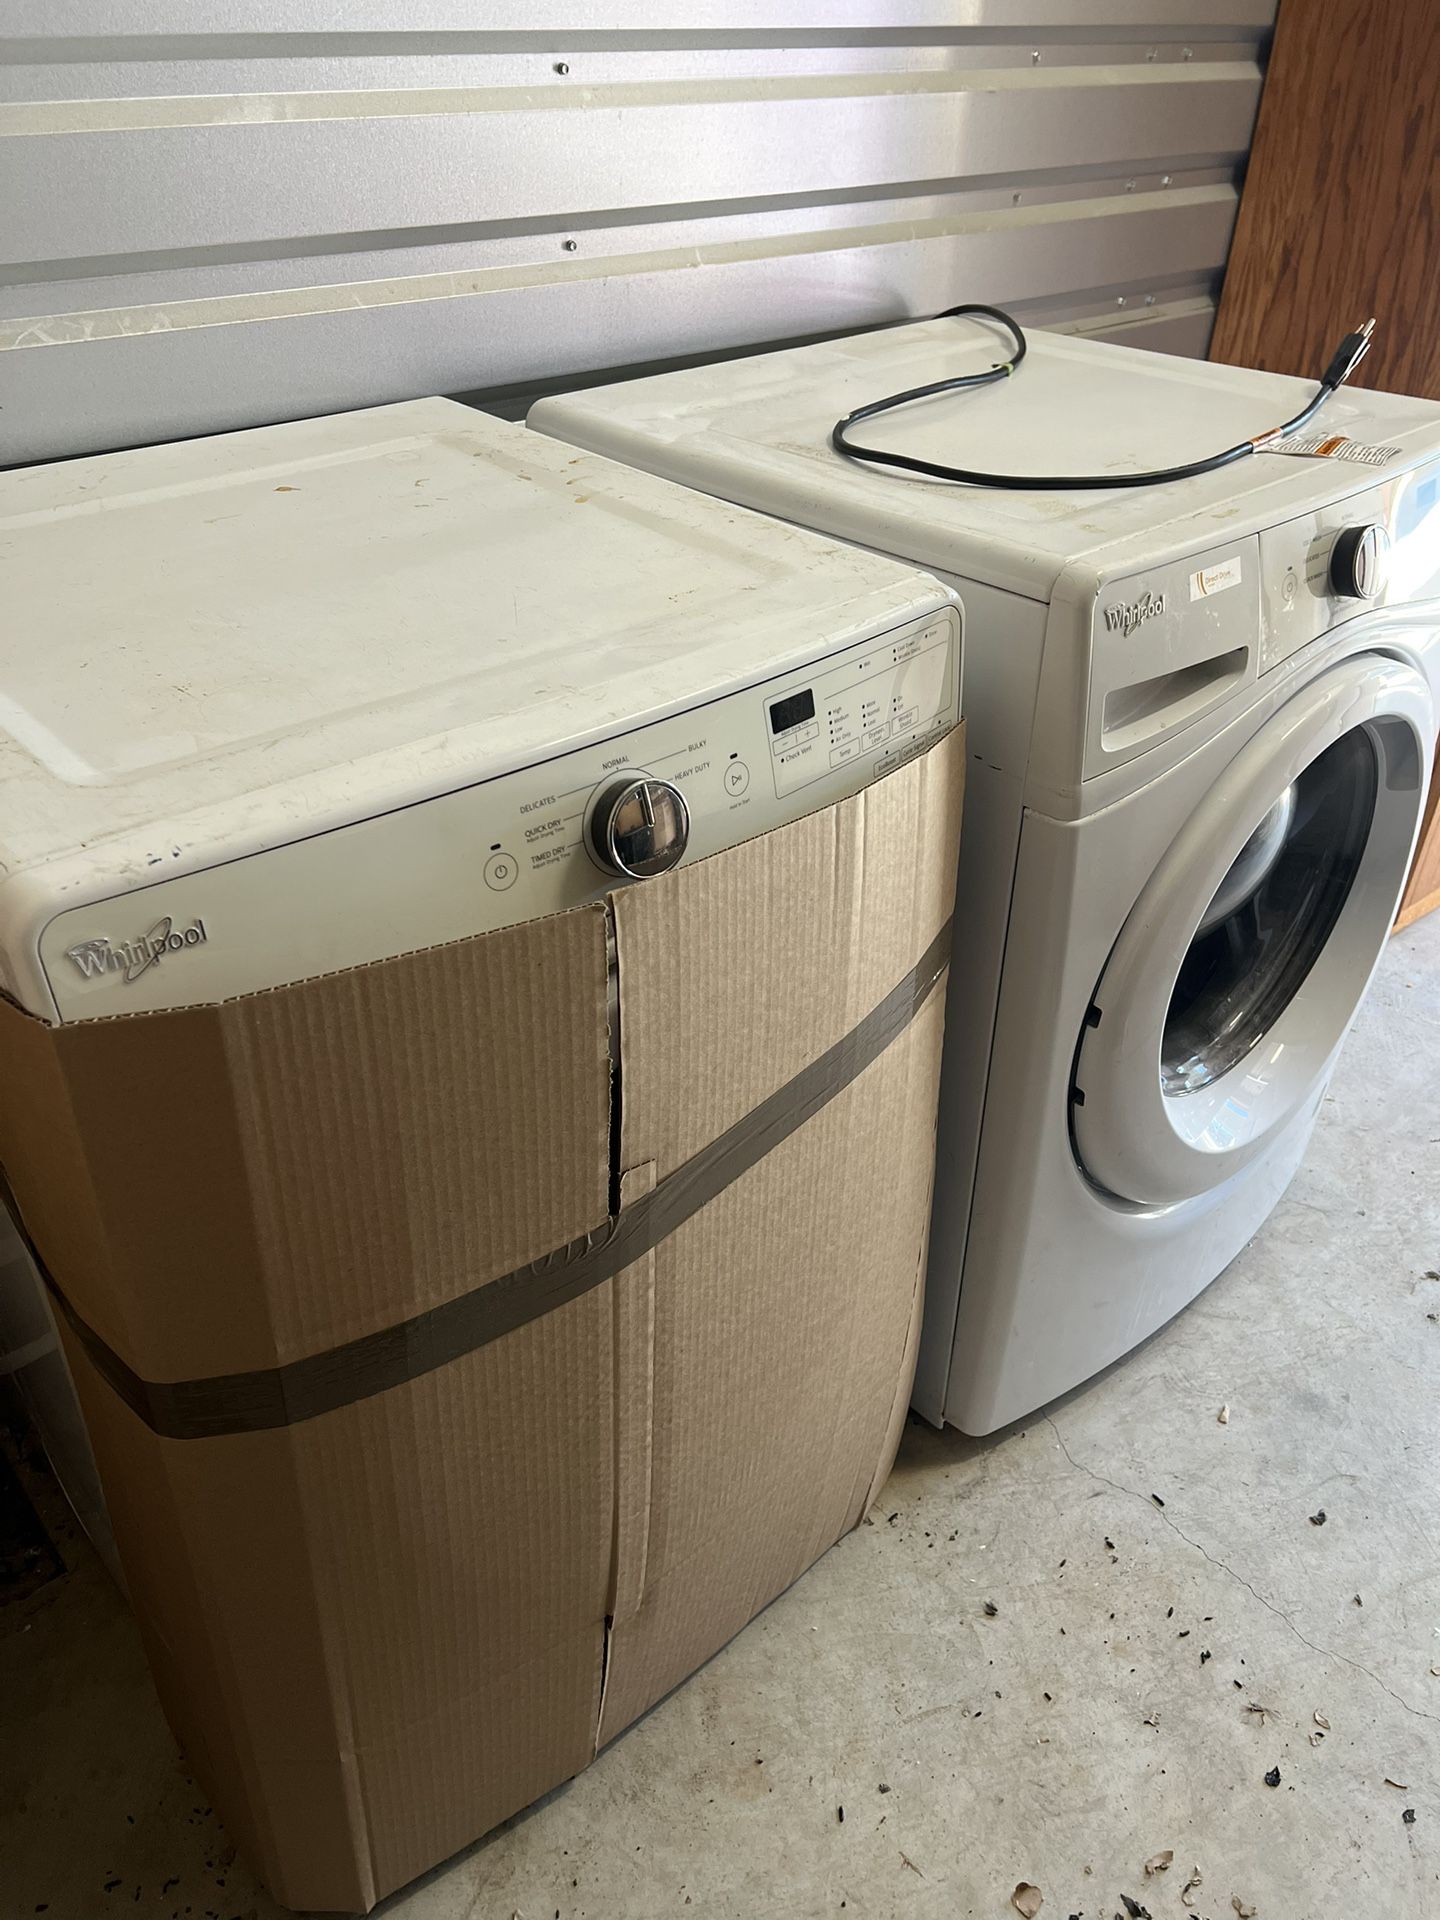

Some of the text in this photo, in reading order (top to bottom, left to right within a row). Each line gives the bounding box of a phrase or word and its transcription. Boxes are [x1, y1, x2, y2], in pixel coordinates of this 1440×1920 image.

[1104, 590, 1166, 638] Whirlpool
[687, 739, 707, 753] BULKY
[785, 745, 812, 762] Check Vent
[602, 755, 629, 771] NORMAL
[674, 761, 711, 781] HEAVY DUTY
[520, 795, 556, 815] DELICATES
[524, 818, 562, 838] QUICK DRY
[530, 844, 567, 864] TIMED DRY
[66, 917, 208, 983] Whirlpool
